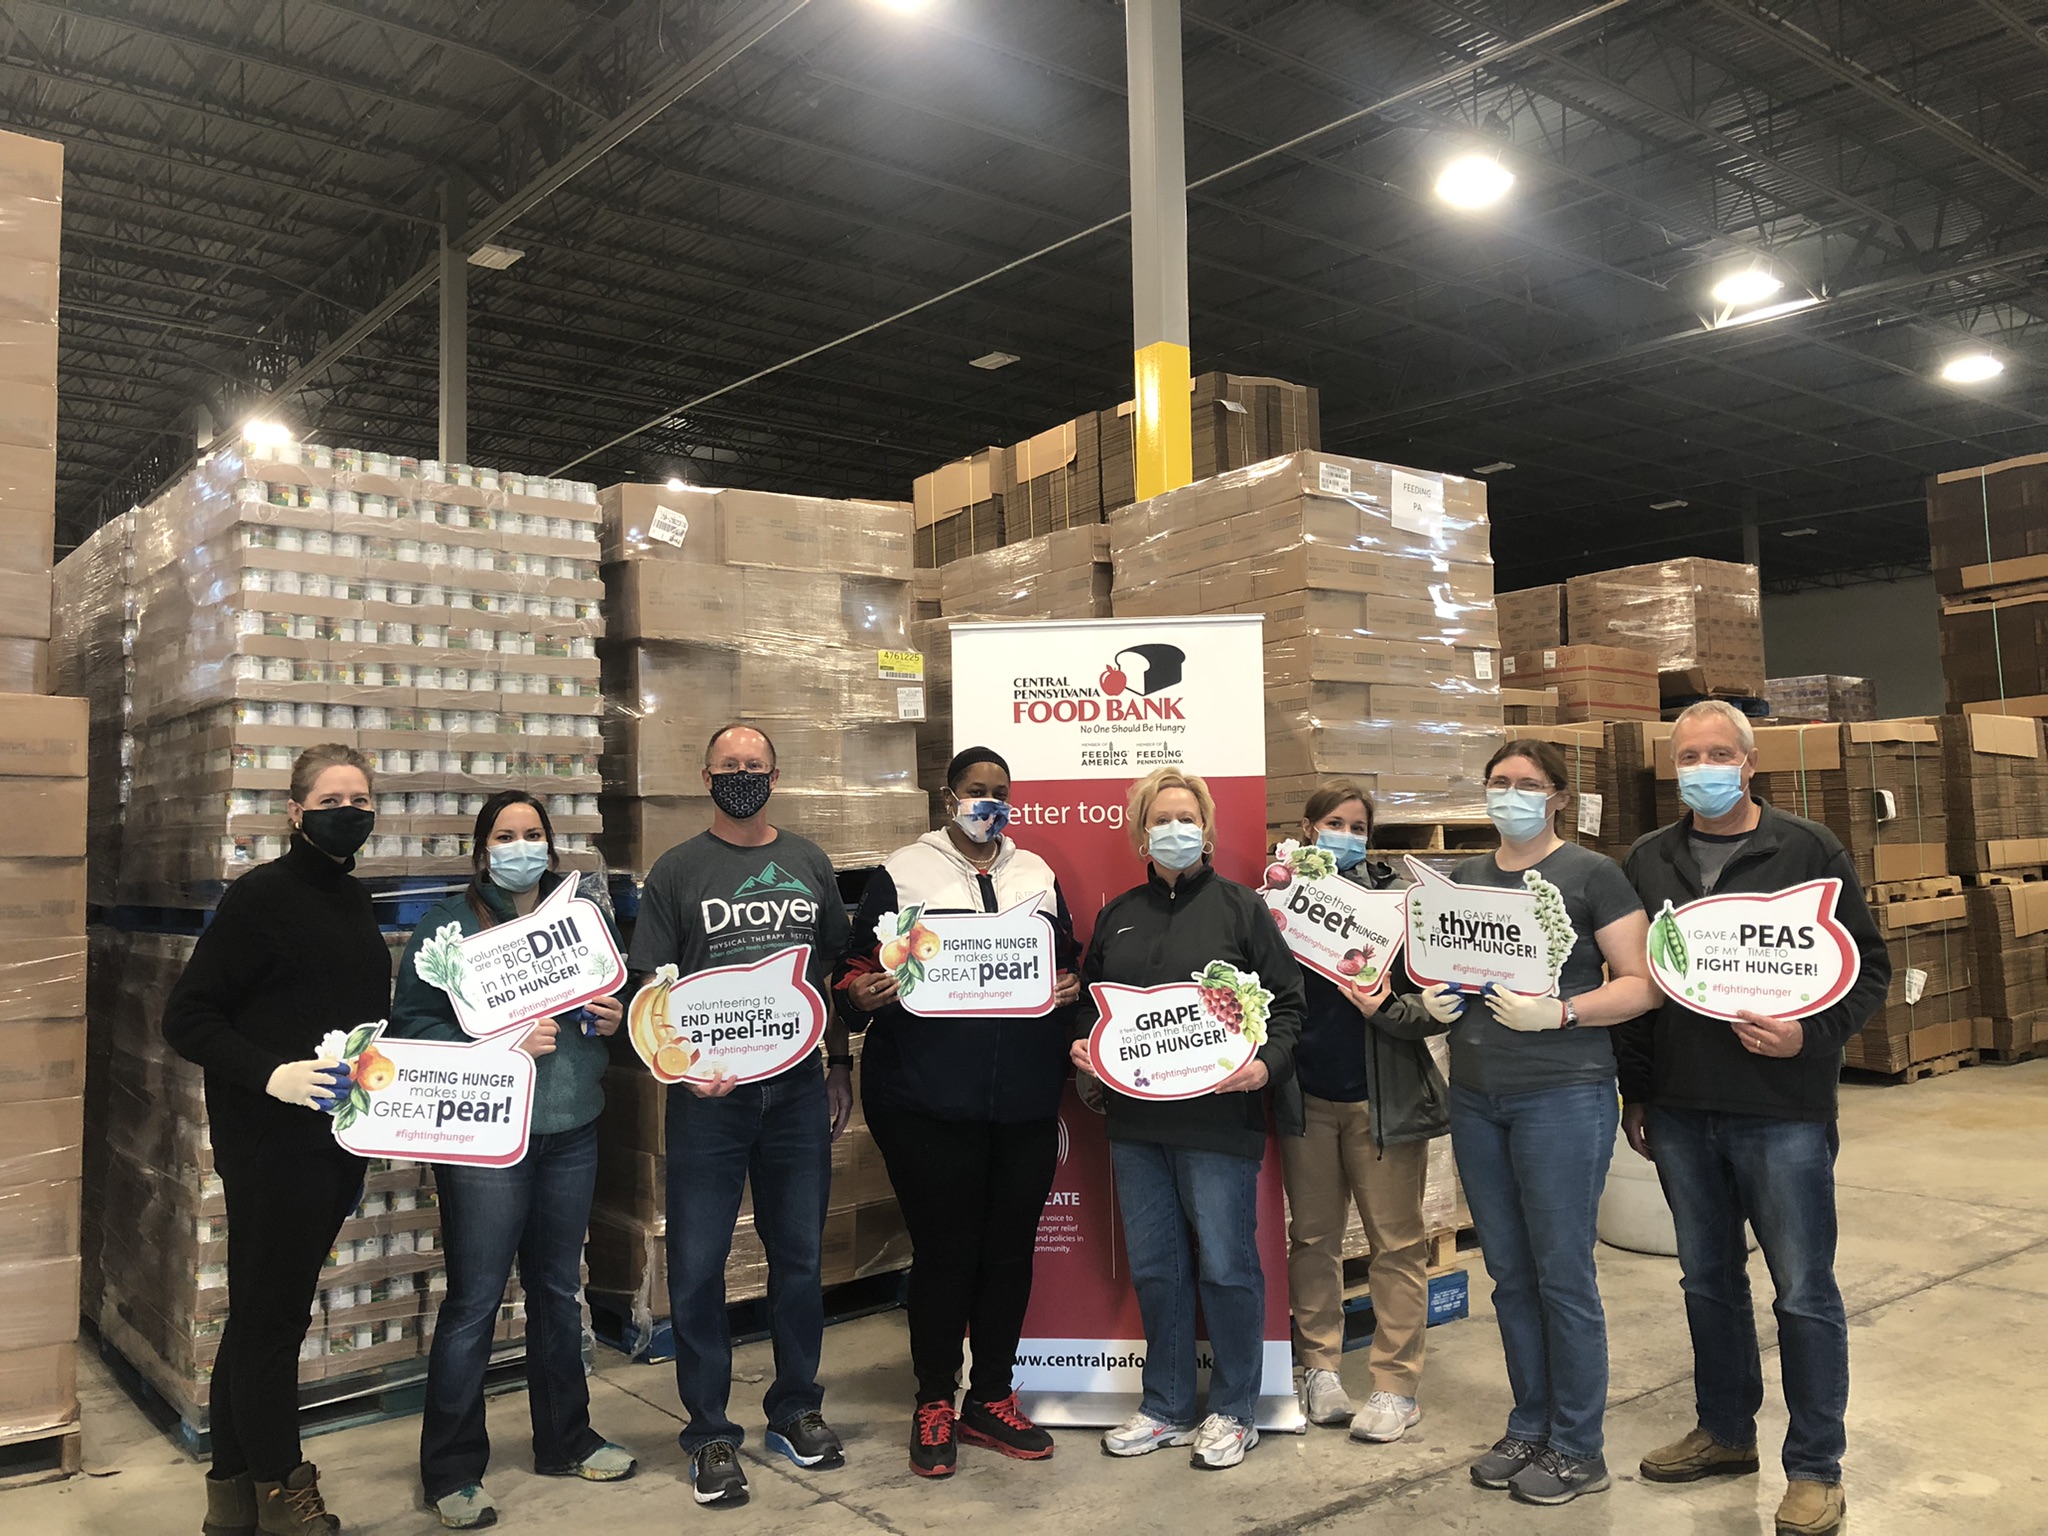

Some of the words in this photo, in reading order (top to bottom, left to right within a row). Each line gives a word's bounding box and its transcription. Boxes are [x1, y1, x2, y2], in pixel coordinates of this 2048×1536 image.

[1403, 482, 1432, 499] FEEDING
[1413, 502, 1422, 512] PA
[883, 651, 920, 662] 4761225
[1013, 676, 1070, 688] CENTRAL
[1014, 688, 1101, 700] PENNSYLVANIA
[1013, 699, 1101, 724] FOOD
[1106, 697, 1186, 722] BANK
[1080, 725, 1092, 734] No
[1093, 724, 1110, 734] One
[1111, 724, 1141, 733] Should
[1143, 723, 1154, 732] Be
[1155, 723, 1186, 734] Hungry
[1081, 750, 1129, 759] FEEDING
[1081, 758, 1128, 766] AMERICA
[1136, 750, 1183, 758] FEEDING
[1008, 802, 1071, 826] etter
[1077, 801, 1130, 830] tog
[1303, 882, 1358, 916] together
[701, 898, 819, 935] Drayer
[1287, 884, 1357, 940] beet
[1352, 924, 1390, 948] HUNGER!
[1463, 909, 1493, 922] GAVE
[1496, 913, 1512, 923] MY
[1432, 925, 1441, 935] to
[1438, 910, 1521, 944] thyme
[475, 961, 491, 972] are
[494, 957, 501, 965] a
[502, 947, 531, 969] BIG
[526, 916, 582, 959] Dill
[709, 937, 747, 952] PHYSICAL
[751, 933, 786, 943] THERAPY
[943, 938, 992, 951] FIGHTING
[995, 937, 1038, 950] HUNGER
[1288, 927, 1343, 959] #fightinghunger
[1430, 933, 1468, 950] FIGHT
[1473, 939, 1537, 959] HUNGER!
[1687, 929, 1691, 939] I
[1694, 930, 1727, 941] GAVE
[1729, 931, 1739, 941] A
[1740, 924, 1815, 950] PEAS
[467, 937, 527, 964] volunteers
[954, 951, 993, 963] makes
[996, 953, 1008, 962] us
[1012, 953, 1020, 962] a
[1705, 945, 1720, 955] OF
[1722, 946, 1739, 956] MY
[1748, 947, 1771, 958] TIME
[1774, 949, 1789, 958] TO
[480, 981, 498, 995] in
[500, 969, 528, 987] the
[531, 950, 568, 974] fight
[571, 946, 589, 959] to
[928, 967, 978, 983] GREAT
[979, 955, 1040, 987] pear!
[1453, 963, 1516, 979] #fightinghunger
[1696, 958, 1740, 973] FIGHT
[1745, 960, 1819, 977] HUNGER!
[487, 989, 516, 1009] END
[518, 963, 581, 996] HUNGER!
[948, 990, 1013, 1000] #fightinghunger
[1712, 984, 1793, 998] #fightinghunger
[509, 987, 576, 1020] #fightinghunger
[687, 996, 760, 1011] volunteering
[763, 995, 776, 1006] to
[681, 1013, 710, 1028] END
[714, 1009, 773, 1026] HUNGER
[782, 1011, 800, 1019] very
[1135, 1003, 1201, 1031] GRAPE
[691, 1018, 801, 1047] a-peel-ing!
[1121, 1036, 1132, 1044] to
[1133, 1032, 1151, 1045] join
[1153, 1030, 1162, 1038] in
[1163, 1026, 1180, 1037] the
[1181, 1022, 1204, 1034] fight
[1205, 1020, 1216, 1029] to
[708, 1042, 779, 1058] #fightinghunger
[1119, 1043, 1151, 1061] END
[1156, 1028, 1228, 1055] HUNGER!
[398, 1068, 458, 1085] FIGHTING
[462, 1071, 515, 1089] HUNGER
[1150, 1063, 1216, 1081] #fightinghunger
[409, 1084, 457, 1100] makes
[461, 1088, 477, 1100] us
[480, 1089, 490, 1101] a
[373, 1101, 436, 1120] GREAT
[435, 1096, 512, 1127] pear!
[395, 1129, 475, 1144] #fightinghunger
[1046, 1214, 1065, 1222] voice
[1065, 1214, 1074, 1222] to
[1060, 1224, 1079, 1232] relief
[1049, 1234, 1076, 1243] policies
[1077, 1234, 1084, 1242] in
[1034, 1245, 1072, 1254] ommunity.
